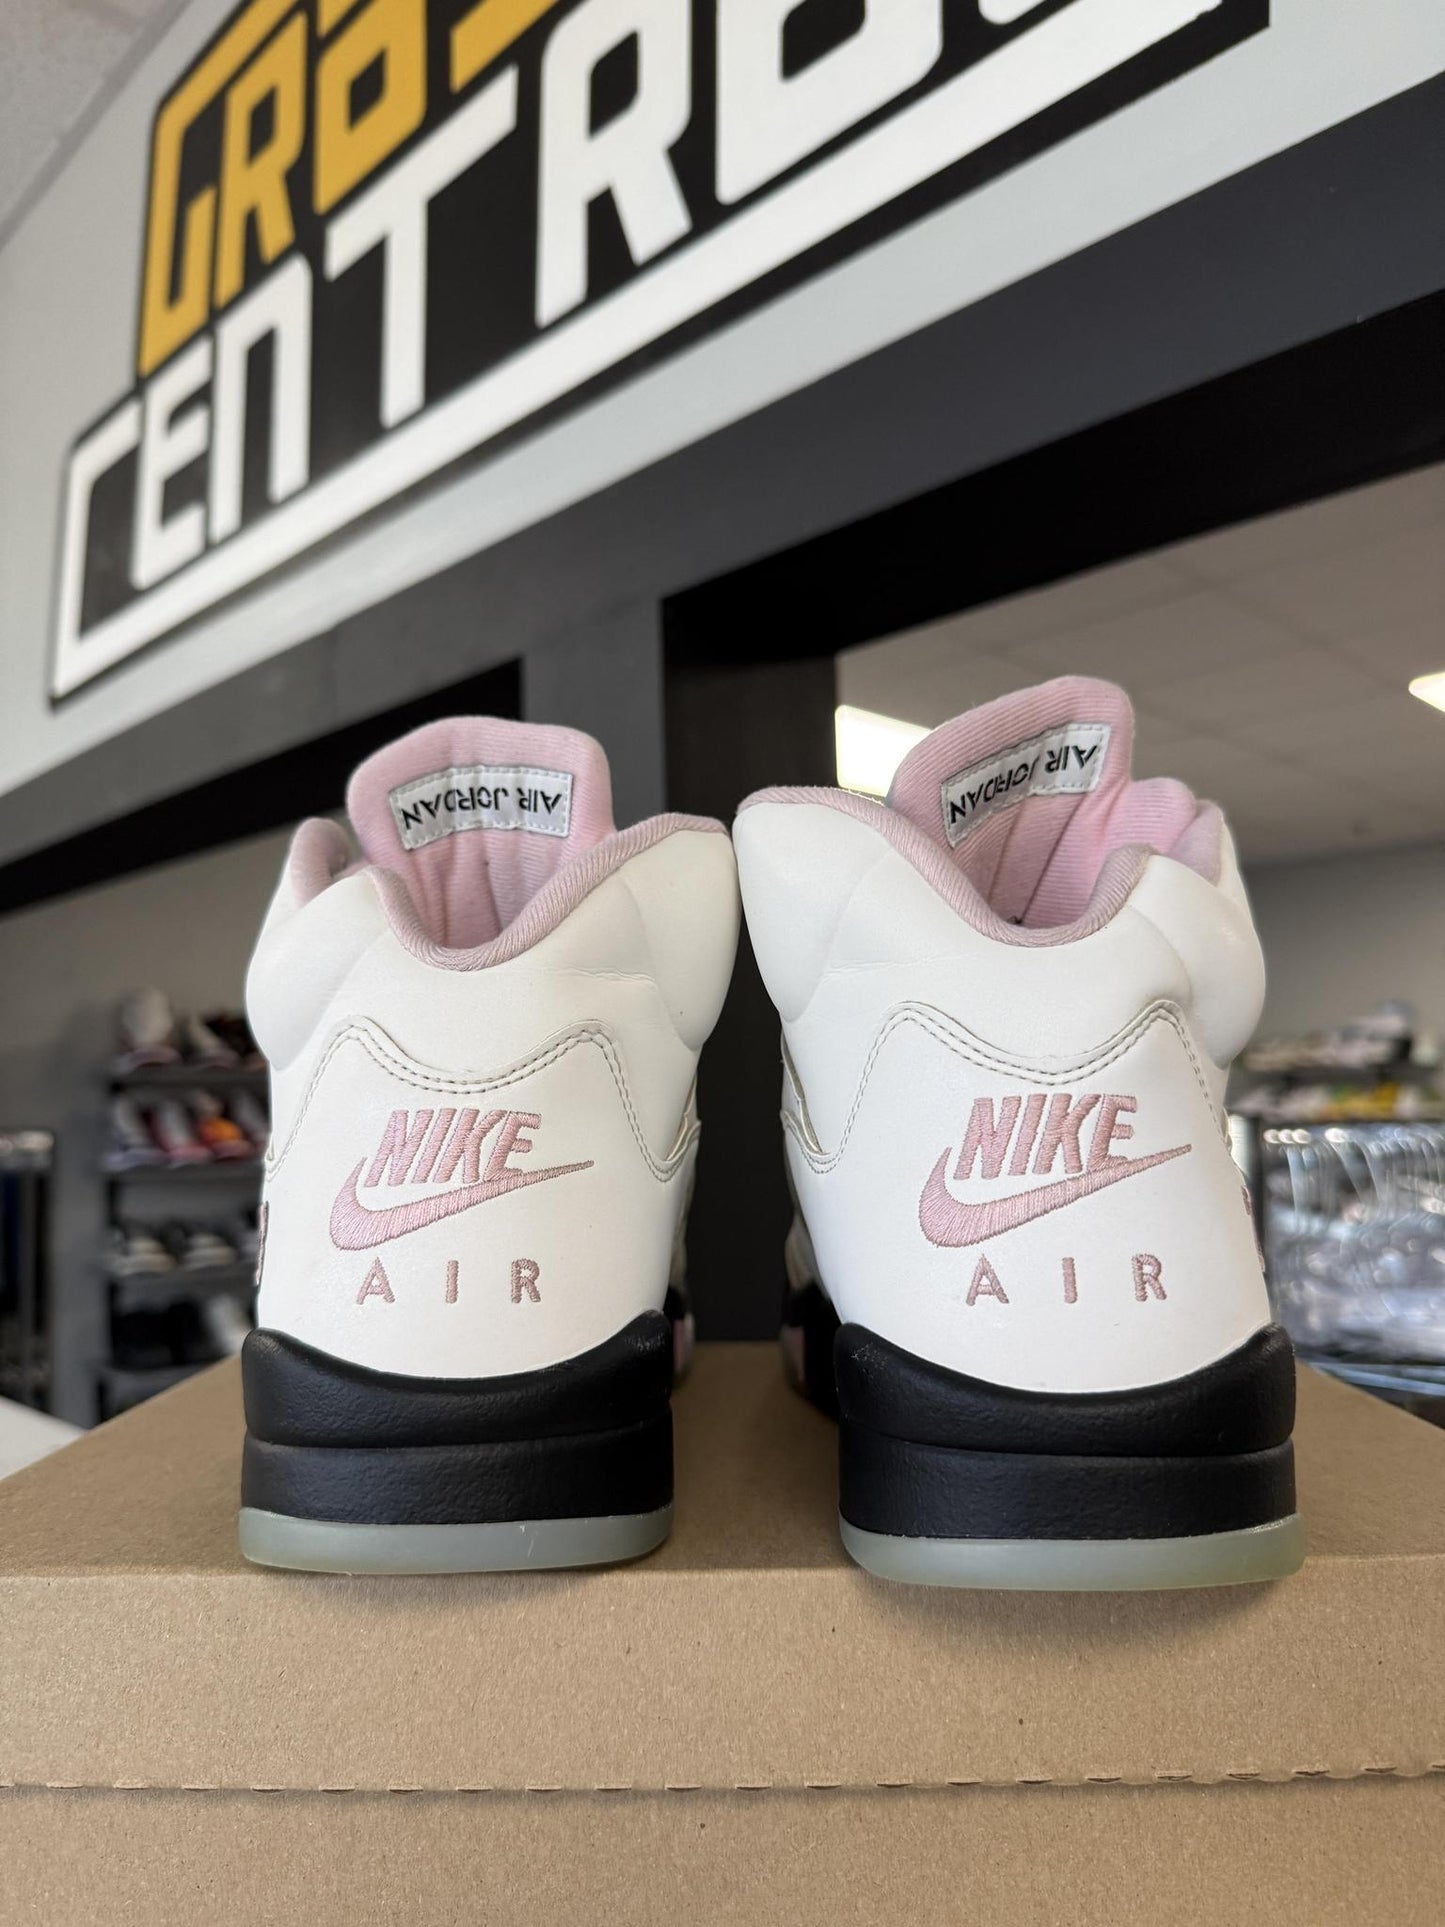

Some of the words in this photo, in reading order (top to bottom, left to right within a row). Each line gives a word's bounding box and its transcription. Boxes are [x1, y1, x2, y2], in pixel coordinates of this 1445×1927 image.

[1045, 745, 1098, 776] AIR
[401, 786, 509, 830] JORDAN
[516, 786, 562, 815] AIR
[950, 757, 1039, 824] JORDAN
[364, 1107, 542, 1187] NIKE
[953, 1093, 1137, 1180] NIKE
[356, 1256, 542, 1305] AIR
[965, 1253, 1167, 1306] AIR
